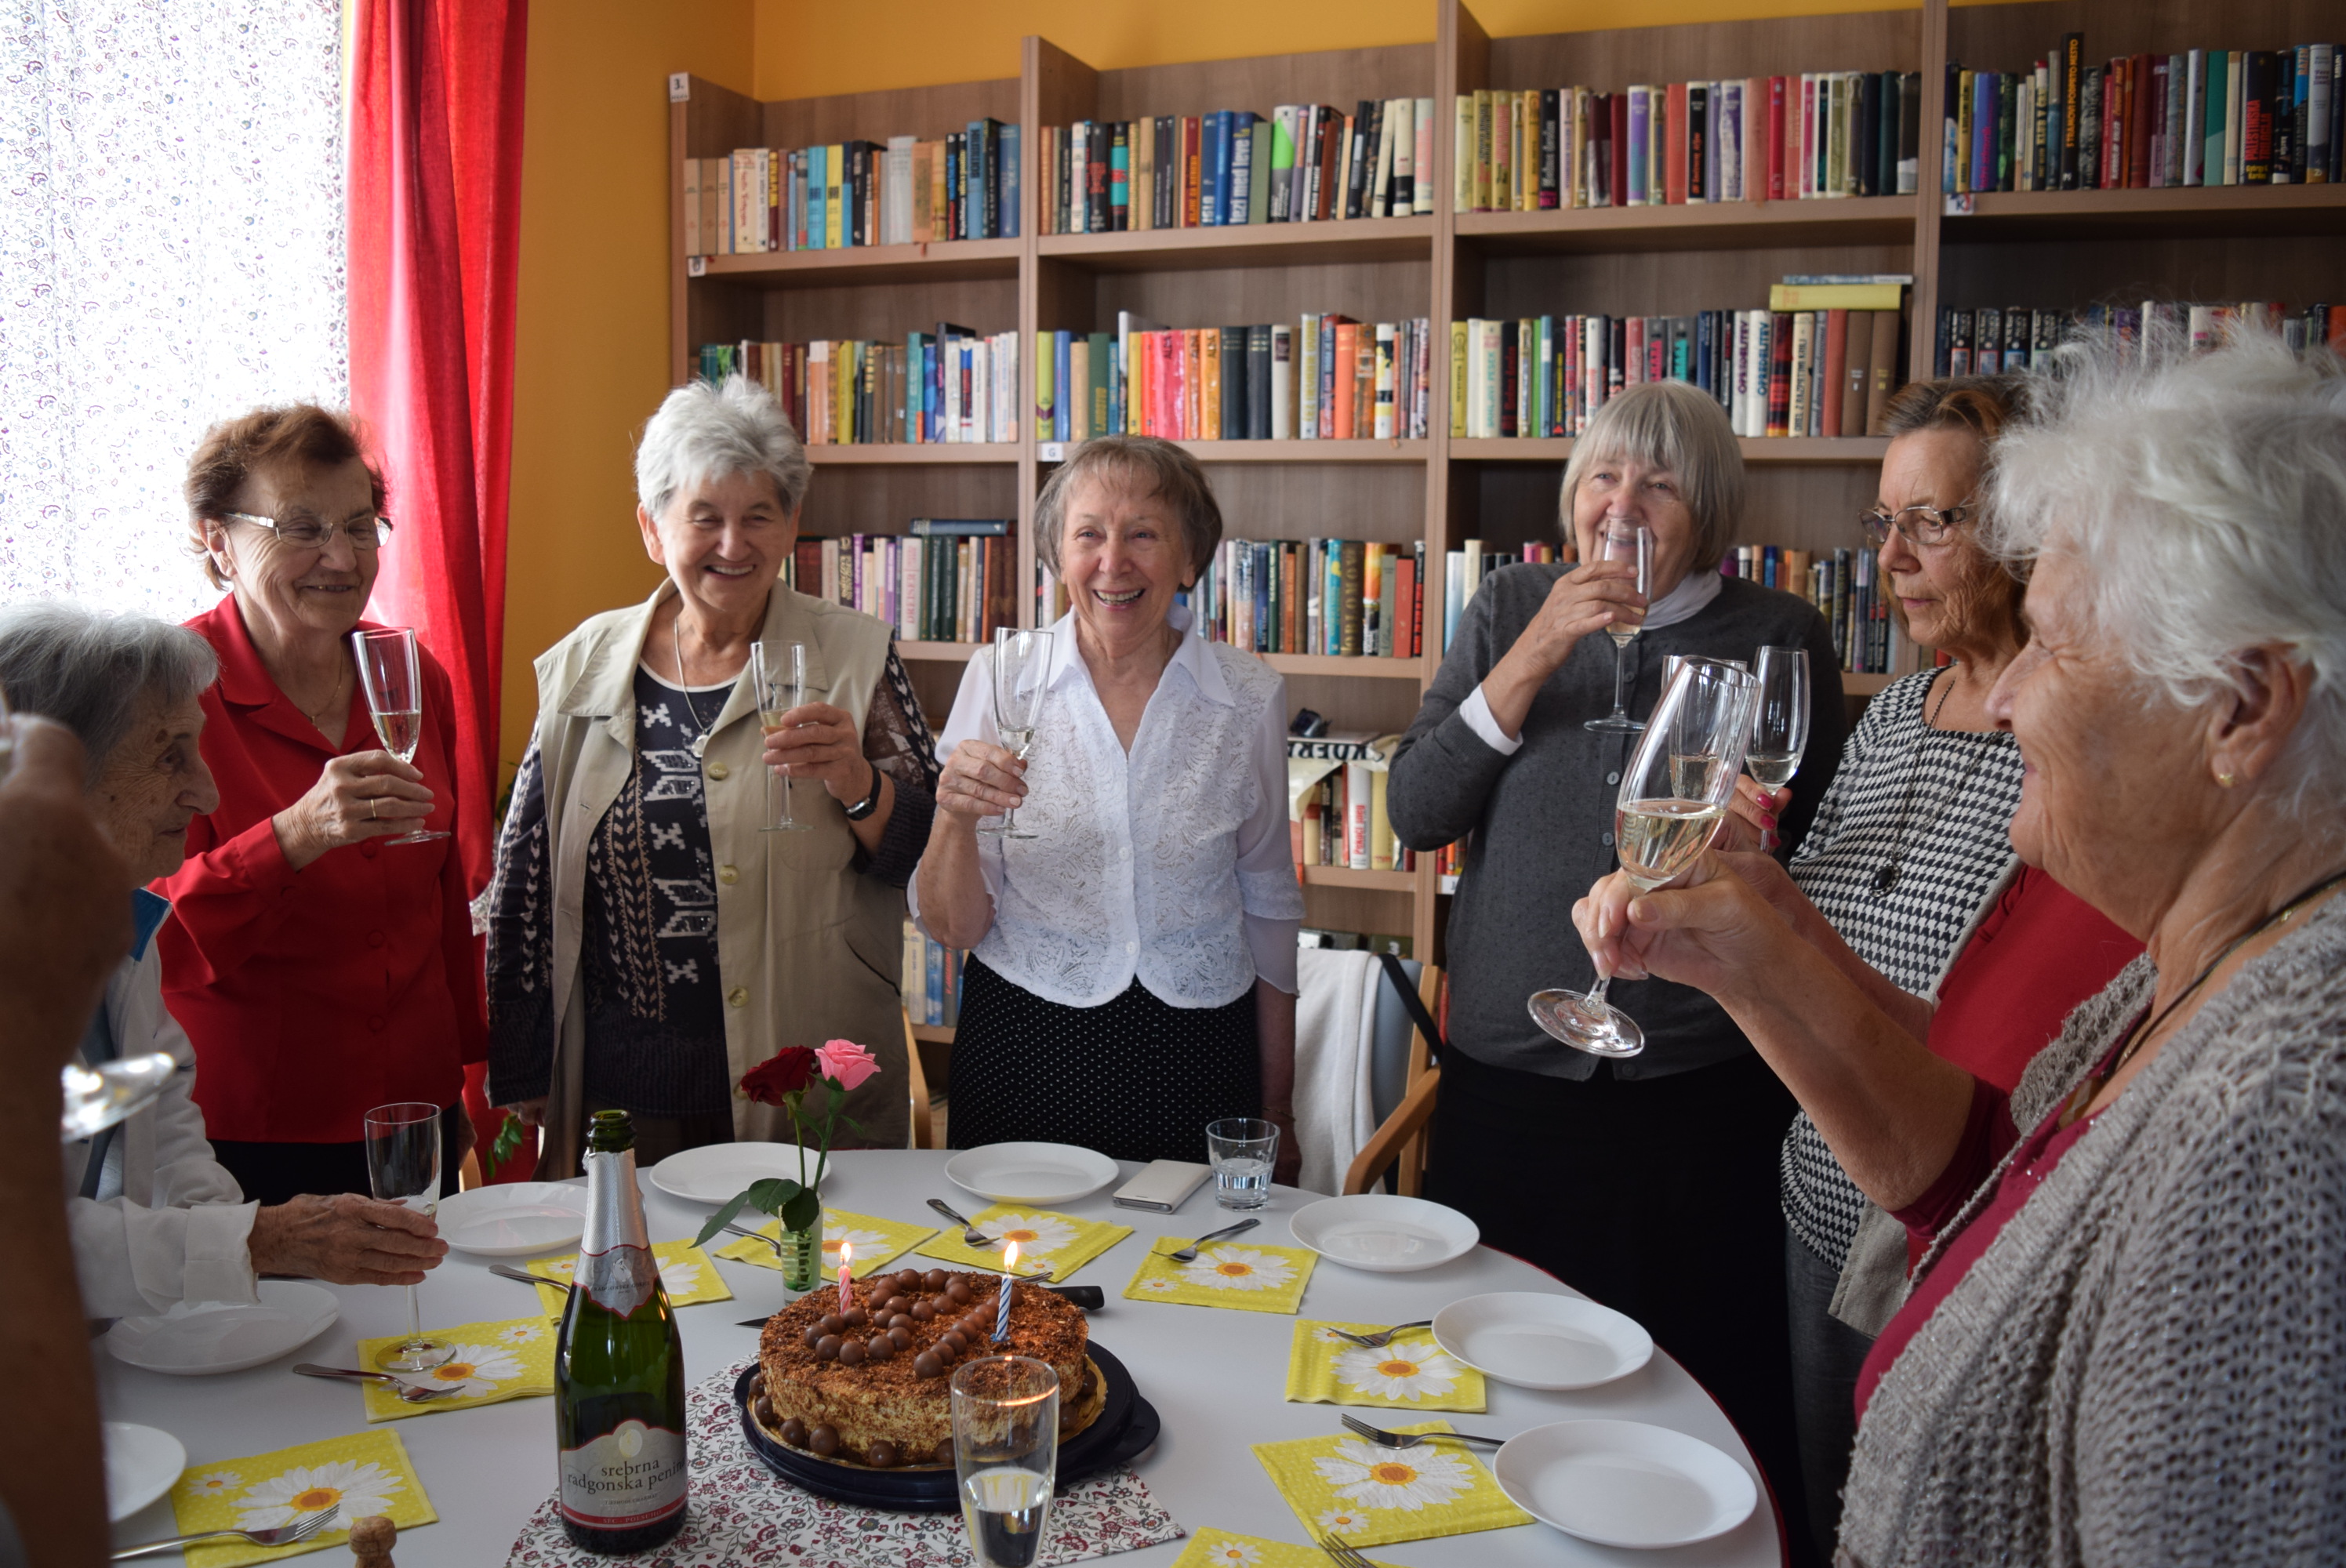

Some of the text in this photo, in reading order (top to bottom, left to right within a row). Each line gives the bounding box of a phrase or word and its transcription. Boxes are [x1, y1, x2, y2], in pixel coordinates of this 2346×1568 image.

[2069, 38, 2078, 67] MESTO
[2067, 67, 2077, 104] PODPRTO
[2065, 104, 2076, 143] TRAMOVI
[2245, 100, 2261, 161] PALESTINSKA
[2260, 113, 2272, 160] TRILOGIJA
[1487, 350, 1495, 381] PESEK
[1738, 321, 1749, 394] OPREDELITEV
[1757, 322, 1769, 396] OPREDELITEV
[1048, 447, 1056, 457] G
[906, 573, 917, 624] DREISER
[568, 1474, 643, 1495] radgonska
[601, 1460, 660, 1476] srebrna
